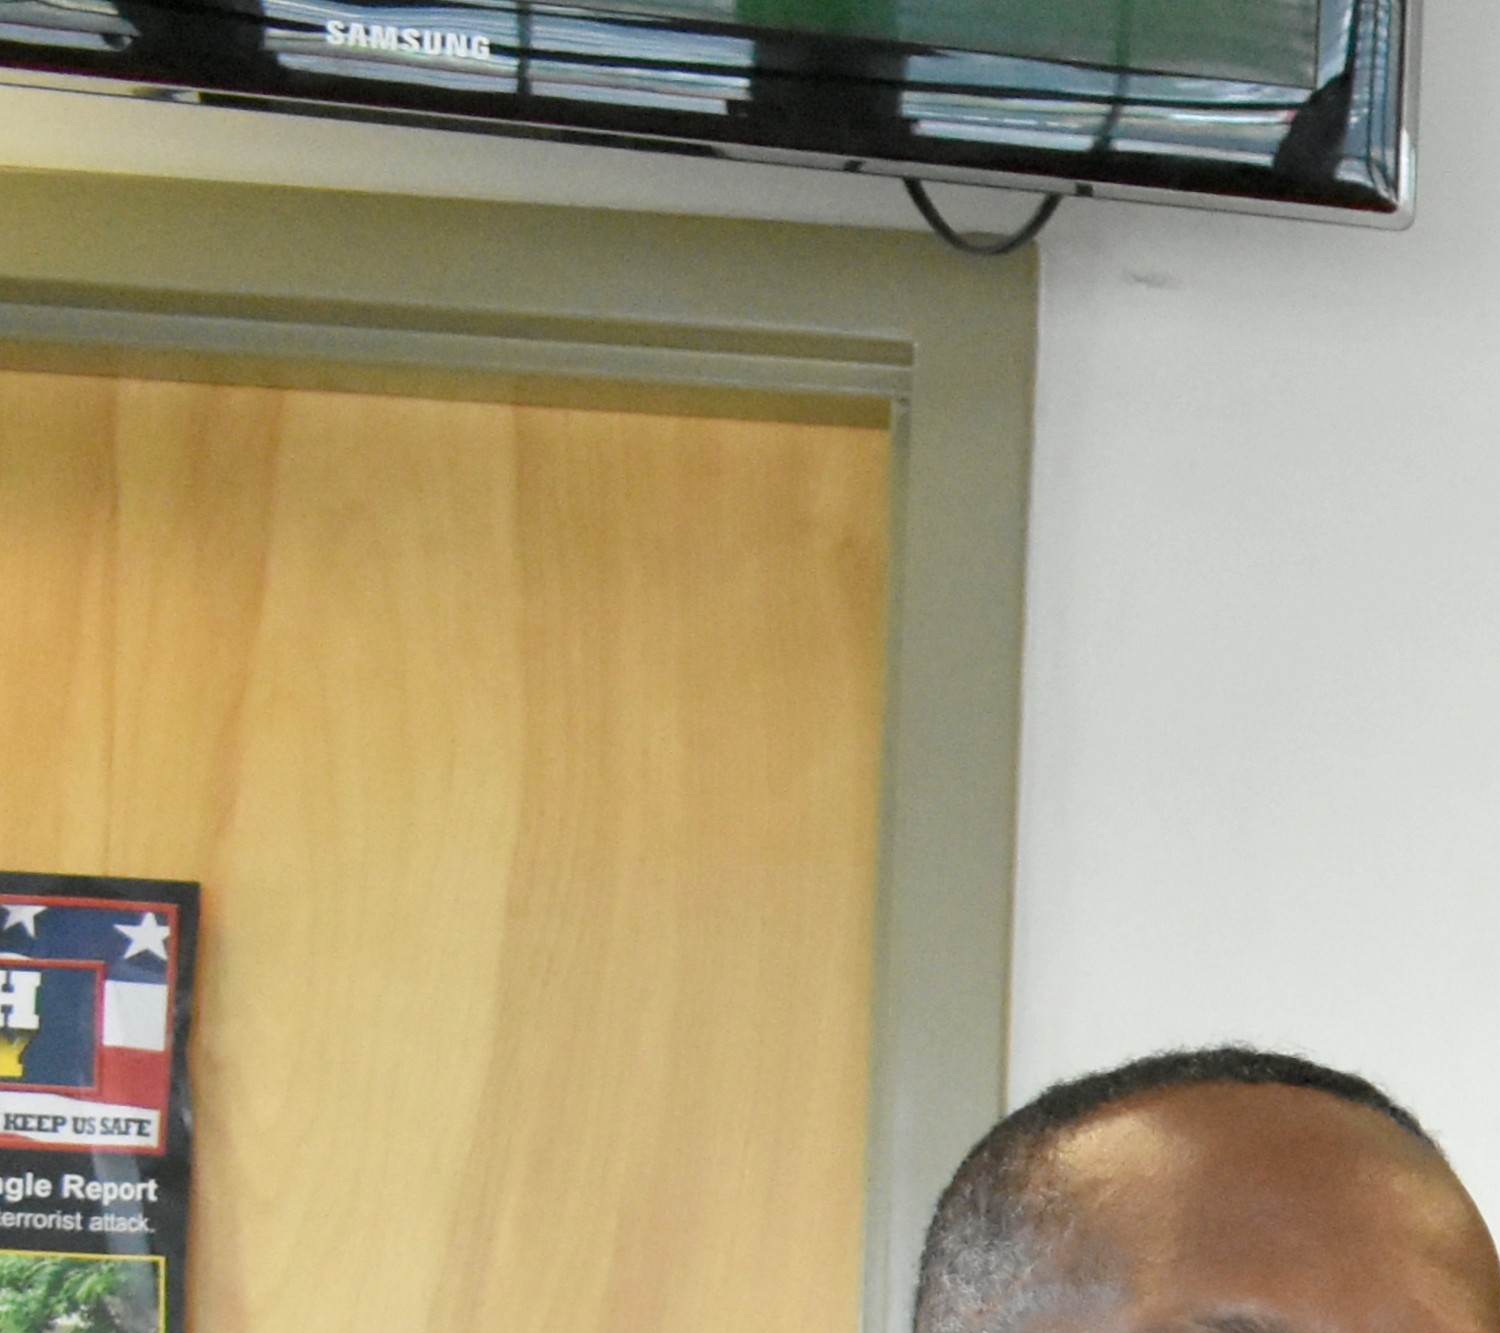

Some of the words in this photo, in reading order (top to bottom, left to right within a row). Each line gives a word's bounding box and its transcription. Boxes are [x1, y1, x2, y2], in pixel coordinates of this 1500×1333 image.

[326, 20, 491, 60] SAMSUNG
[3, 1112, 67, 1134] KEEP
[71, 1116, 97, 1136] US
[100, 1118, 152, 1138] SAFE
[62, 1173, 158, 1207] Report
[88, 1212, 157, 1234] attack.
